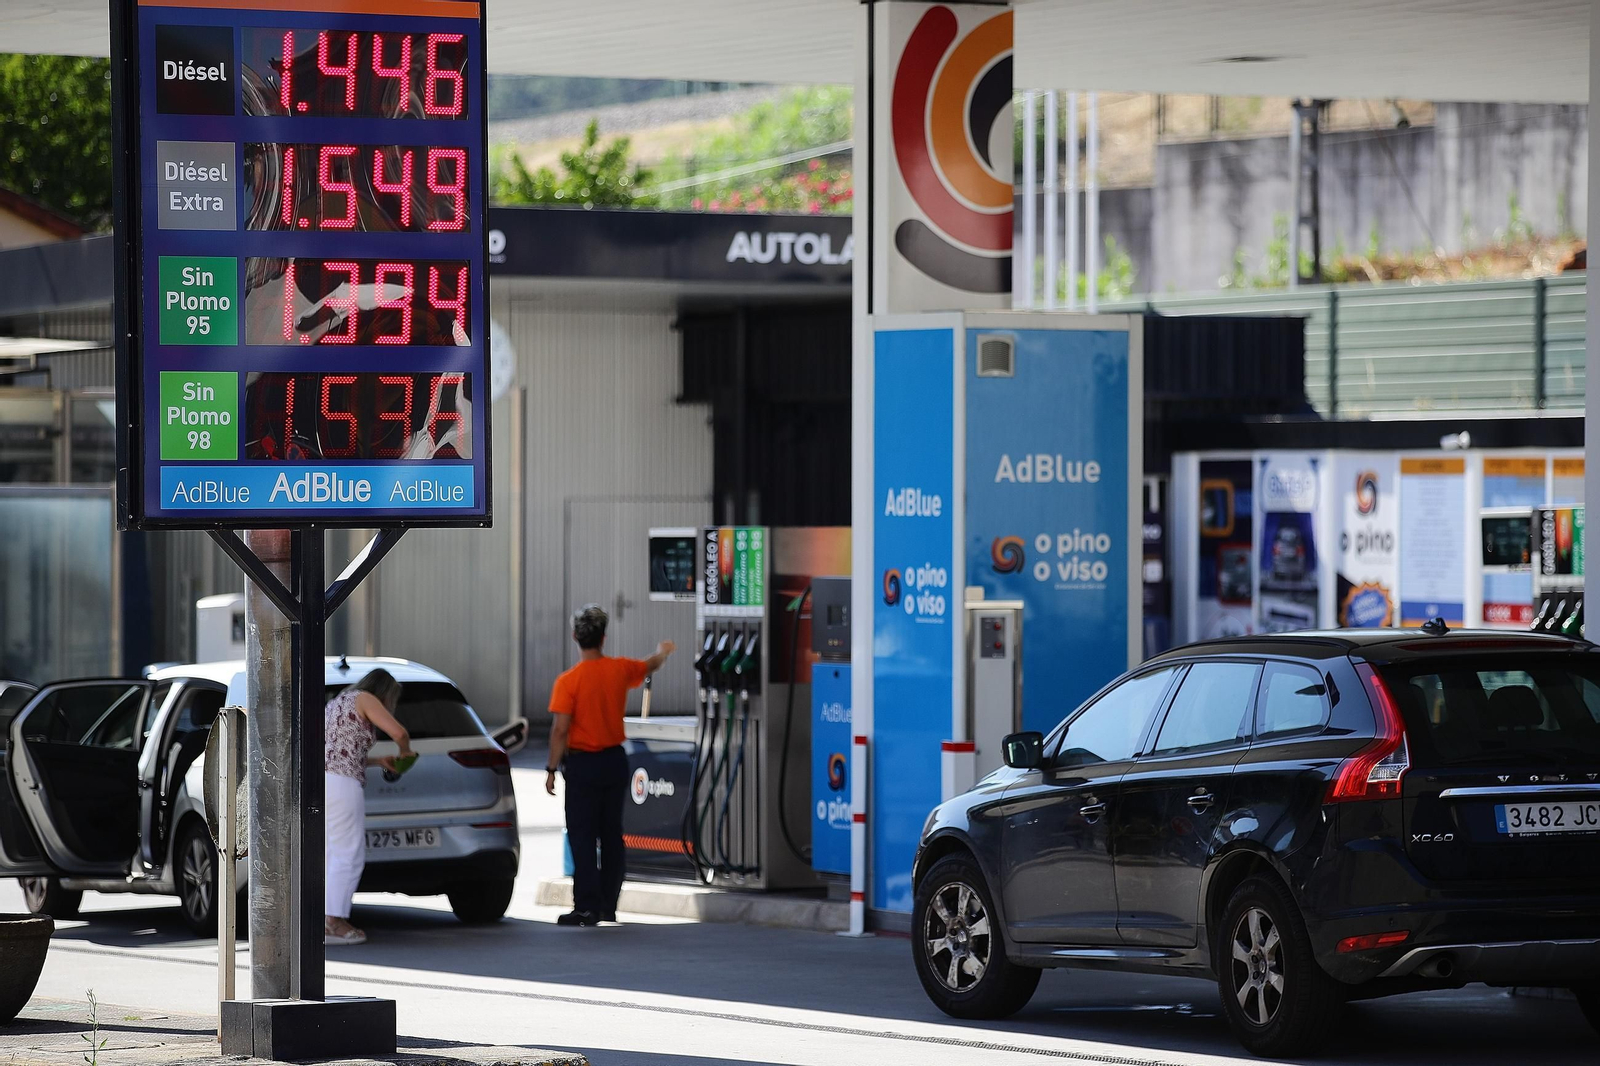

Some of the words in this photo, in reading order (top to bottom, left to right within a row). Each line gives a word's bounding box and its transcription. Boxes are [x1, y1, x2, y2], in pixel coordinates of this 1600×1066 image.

[163, 60, 227, 82] Diésel
[280, 30, 464, 116] 1.446
[165, 161, 228, 182] Diésel
[282, 146, 467, 231] 1.549
[169, 191, 224, 212] Extra
[181, 266, 214, 286] Sin
[166, 291, 231, 311] Plomo
[283, 262, 468, 344] 1.394
[186, 316, 211, 335] 95
[182, 382, 214, 402] Sin
[167, 407, 231, 426] Plomo
[187, 431, 211, 450] 98
[995, 454, 1101, 483] AdBlue
[171, 481, 251, 503] AdBlue
[269, 472, 371, 502] AdBlue
[389, 480, 465, 502] AdBlue
[885, 488, 942, 516] AdBlue
[1035, 533, 1052, 553] o
[1057, 528, 1111, 557] pino
[905, 567, 914, 587] o
[916, 562, 947, 590] pino
[1034, 561, 1051, 581] o
[1057, 557, 1108, 581] viso
[904, 595, 914, 615] o
[917, 591, 946, 616] viso
[817, 800, 826, 820] o
[1509, 805, 1565, 828] 3482
[1574, 804, 1600, 826] JC
[405, 830, 434, 847] MFG
